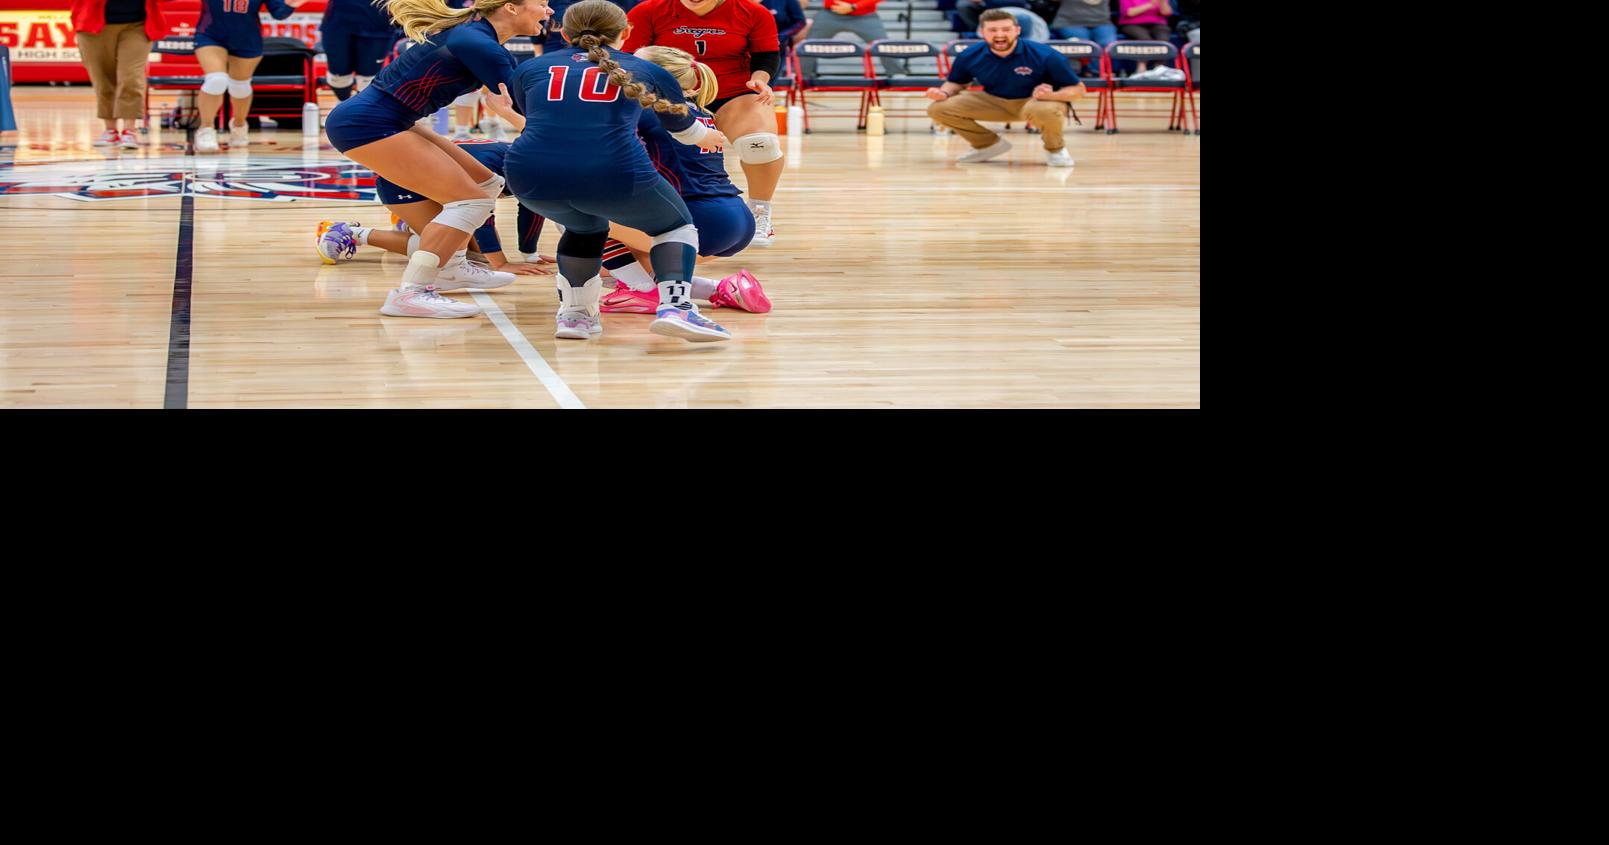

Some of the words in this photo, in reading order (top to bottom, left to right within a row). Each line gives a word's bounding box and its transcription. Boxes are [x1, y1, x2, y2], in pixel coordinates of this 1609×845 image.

[0, 22, 77, 48] SAY
[157, 40, 195, 50] REDSK
[695, 40, 706, 56] 1
[18, 51, 57, 59] HIGH
[547, 66, 627, 103] 10
[666, 285, 685, 295] 11
